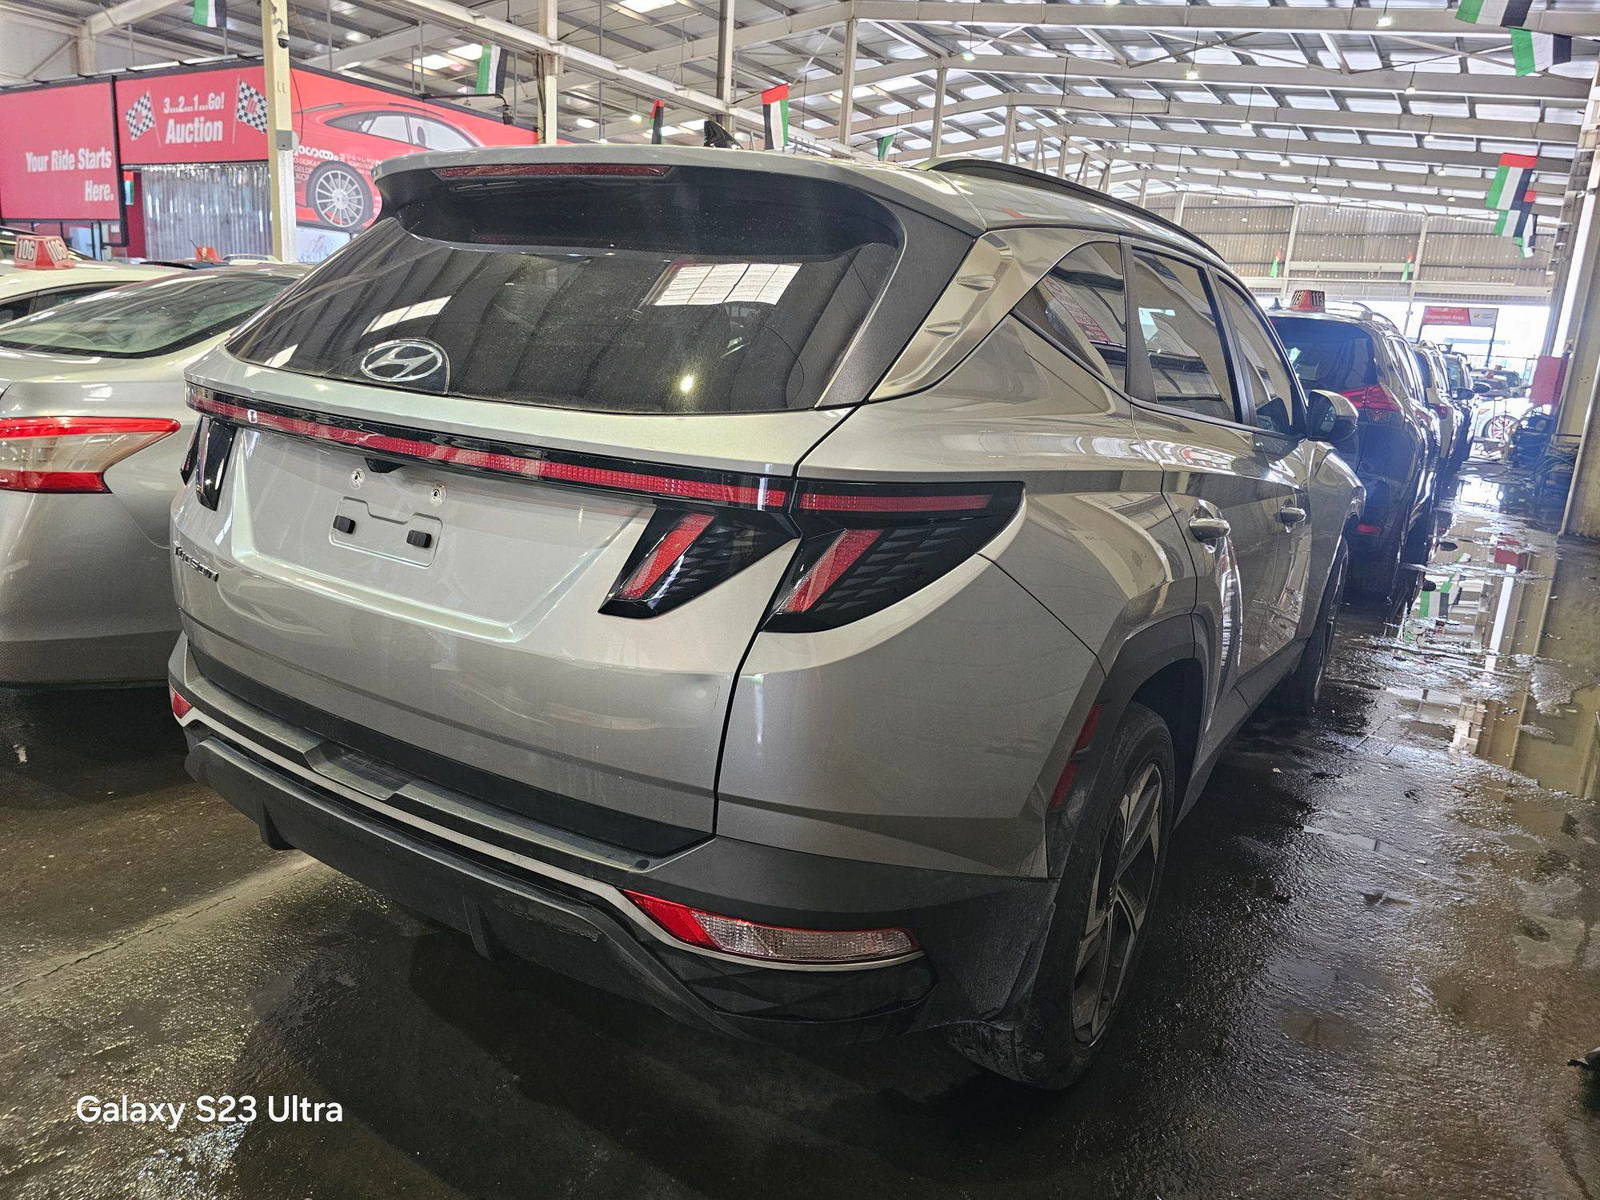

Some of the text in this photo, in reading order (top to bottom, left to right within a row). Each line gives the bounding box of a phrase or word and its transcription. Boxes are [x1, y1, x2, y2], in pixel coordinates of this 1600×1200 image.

[165, 116, 224, 145] Auction
[25, 146, 112, 173] Your Ride Starts
[84, 179, 115, 202] Here.
[18, 239, 36, 260] 106
[47, 239, 69, 261] 106
[1312, 290, 1325, 306] 113
